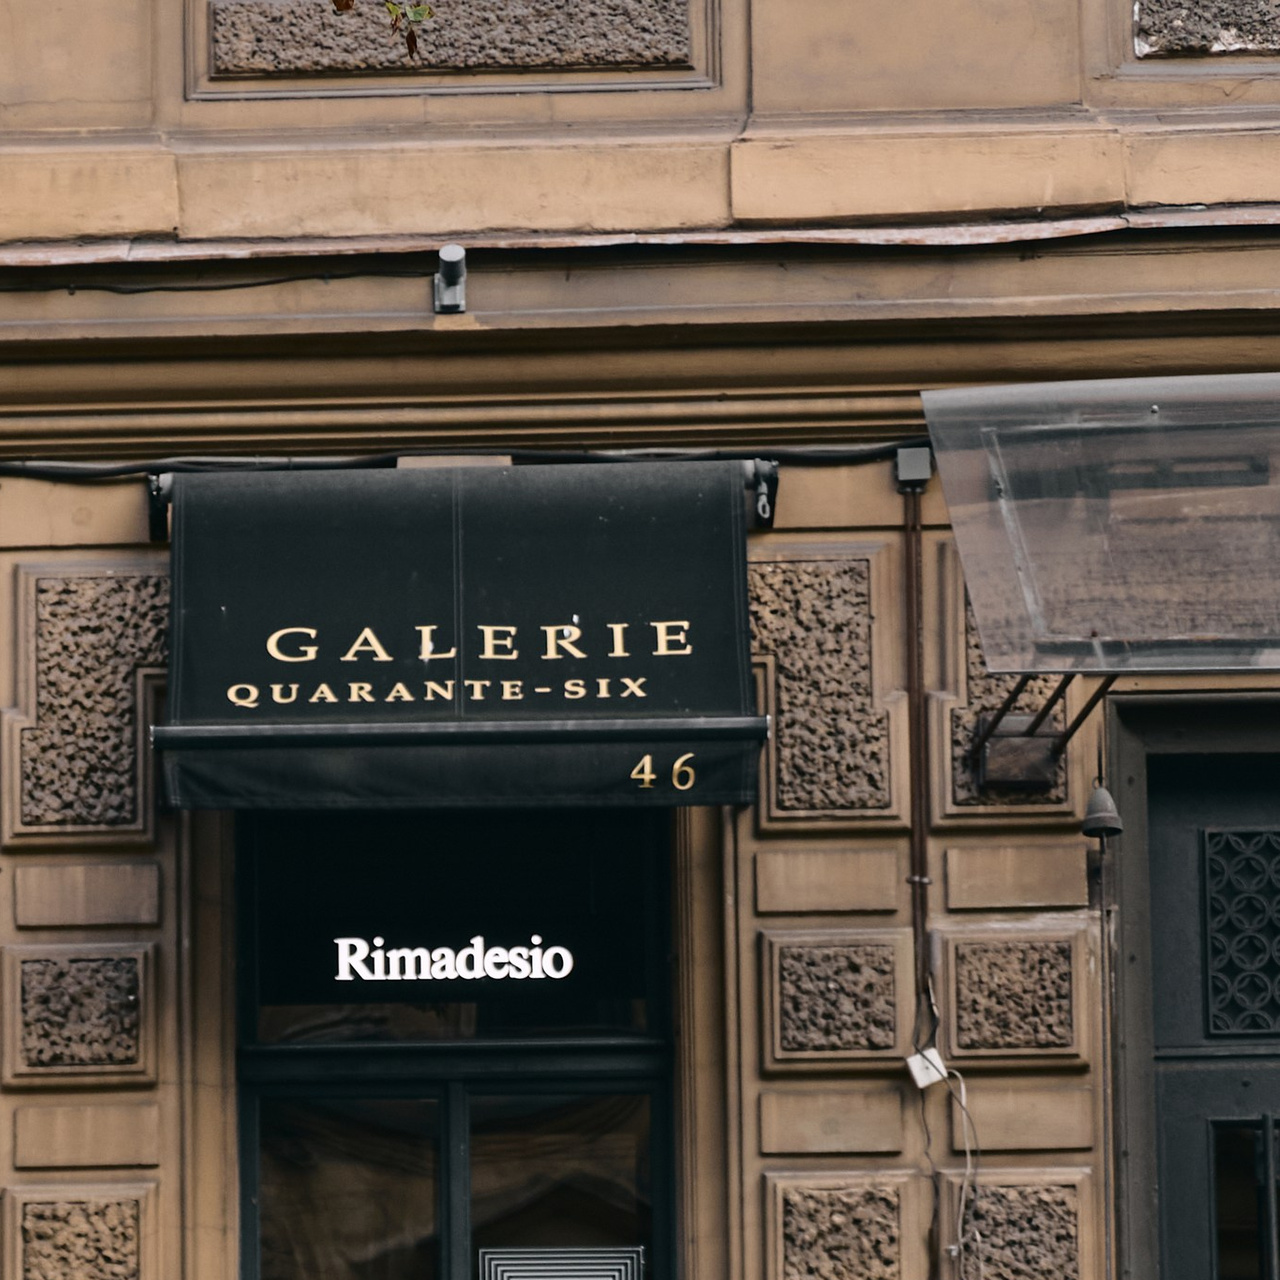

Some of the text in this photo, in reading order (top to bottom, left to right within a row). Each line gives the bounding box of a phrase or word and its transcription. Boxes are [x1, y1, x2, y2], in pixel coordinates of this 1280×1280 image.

[265, 620, 694, 663] GALERIE
[226, 677, 648, 708] QUARANTE-SIX
[629, 752, 696, 791] 46
[333, 934, 575, 981] Rimadesio
